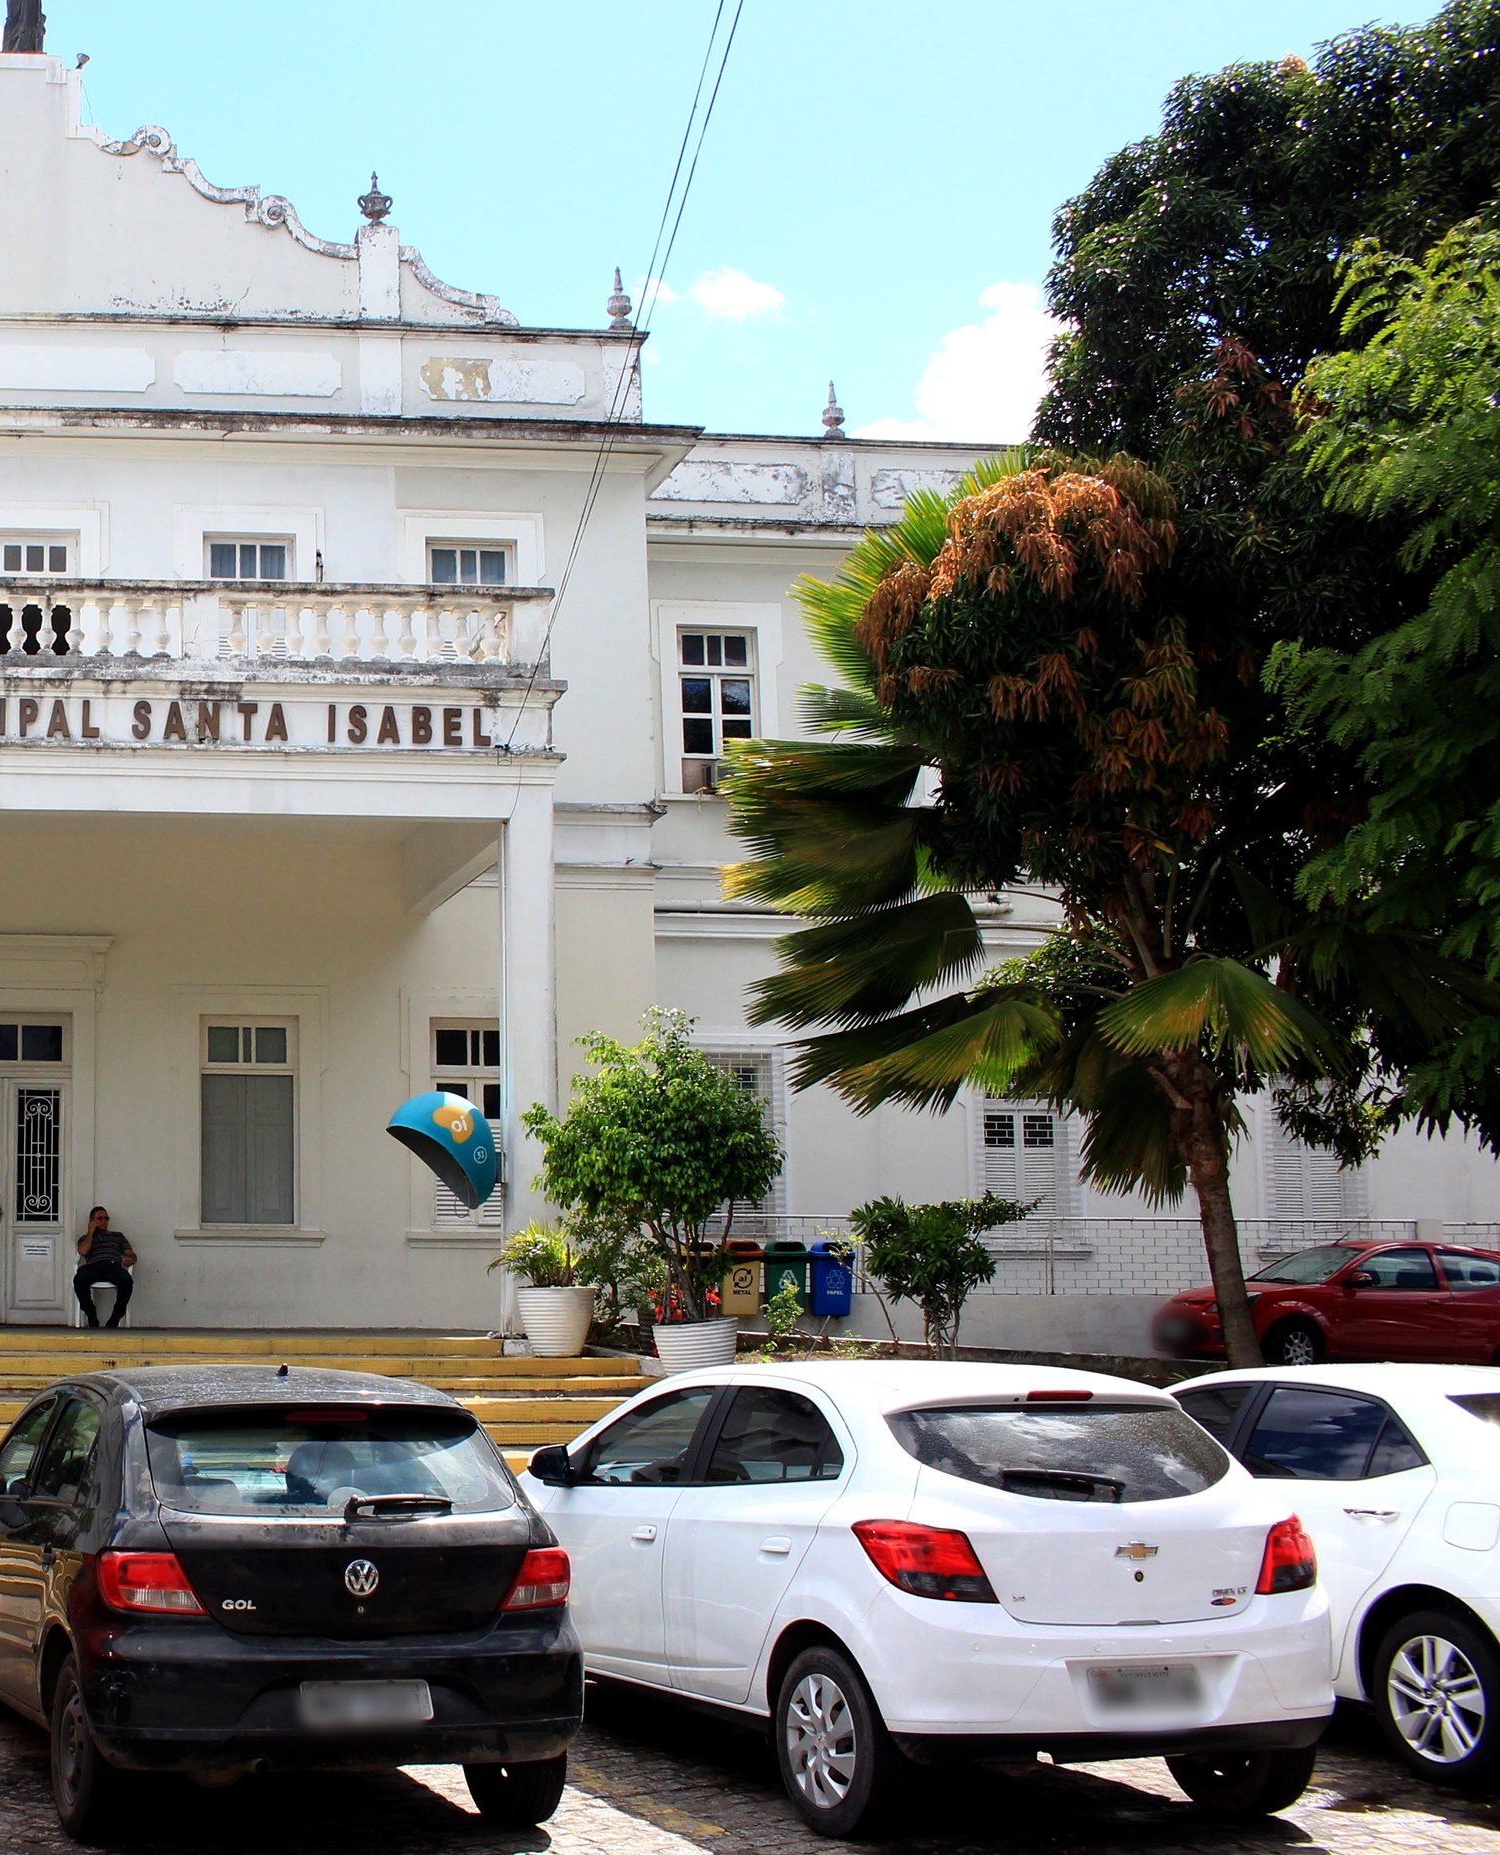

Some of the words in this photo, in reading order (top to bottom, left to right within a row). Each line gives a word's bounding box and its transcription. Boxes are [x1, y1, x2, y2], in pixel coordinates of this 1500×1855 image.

[131, 699, 290, 742] SANTA
[327, 703, 492, 747] ISABEL
[221, 1599, 257, 1610] GOL
